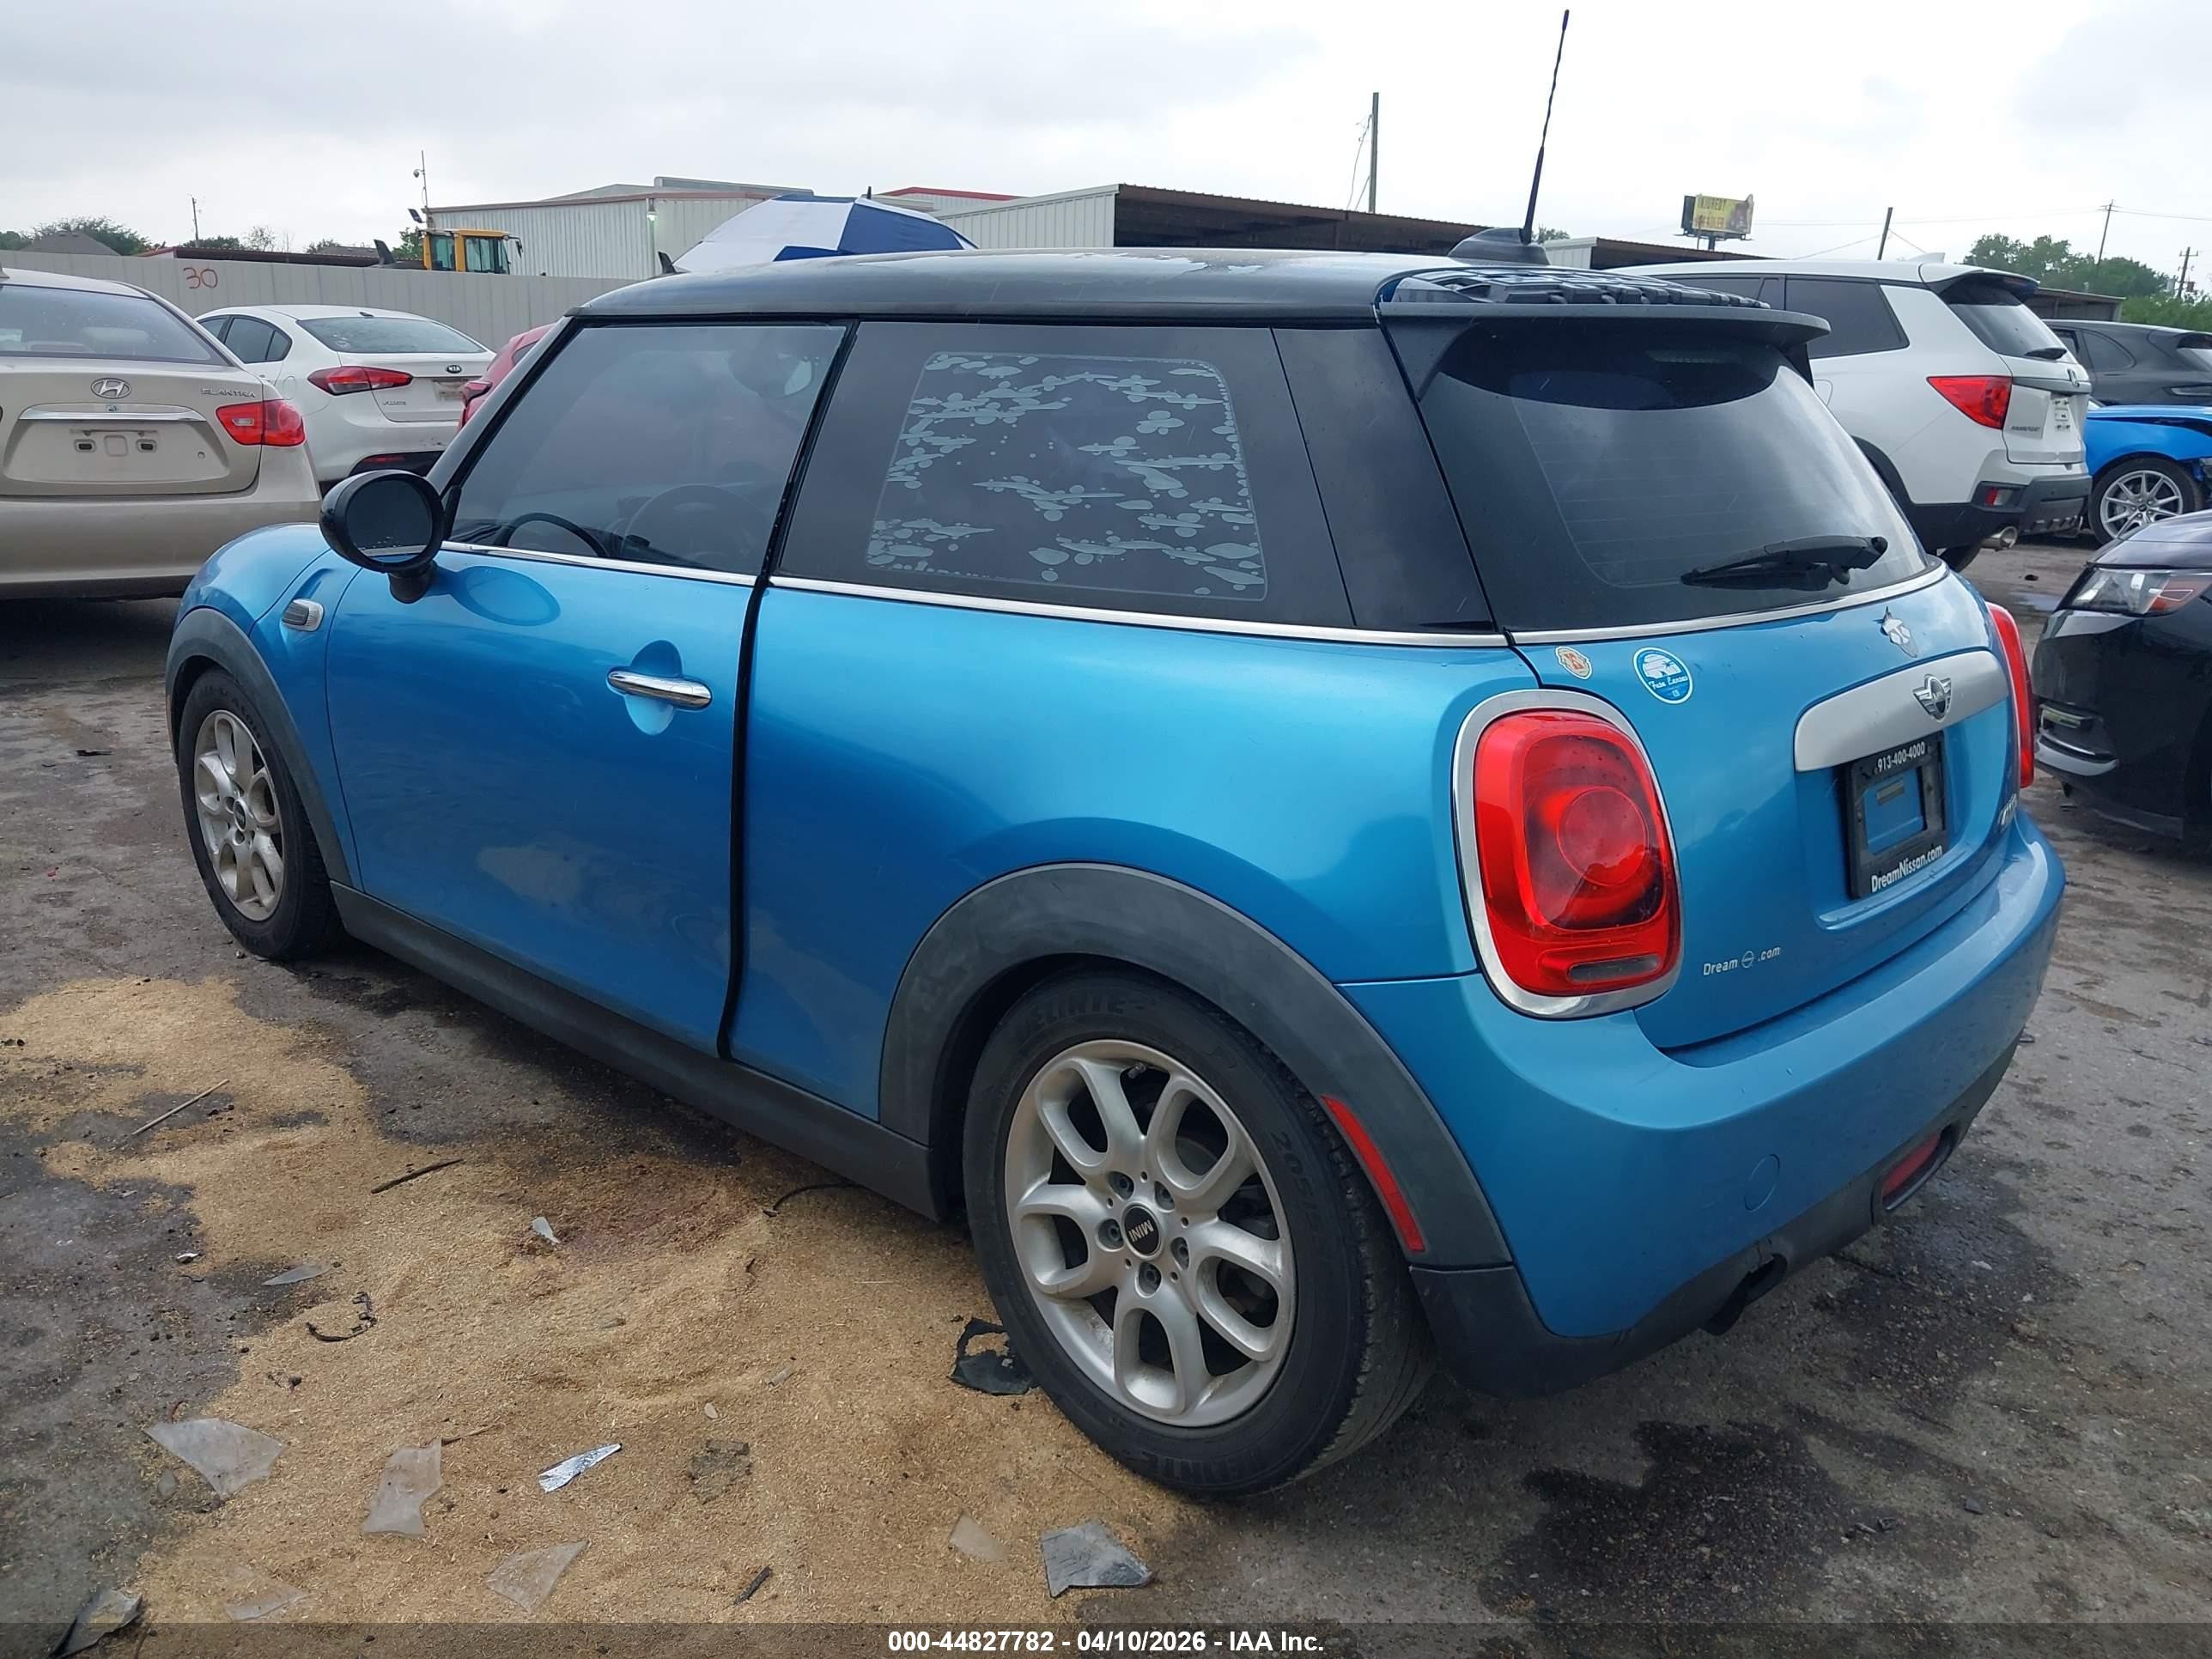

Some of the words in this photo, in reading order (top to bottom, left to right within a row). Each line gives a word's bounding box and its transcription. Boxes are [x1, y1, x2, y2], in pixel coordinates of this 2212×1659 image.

[183, 267, 218, 289] 30
[201, 388, 256, 398] ELANTRA
[1877, 742, 1925, 773] 913-400-4000
[1871, 845, 1942, 893] DreamNissan.com
[1703, 959, 1738, 975] Dream
[1758, 946, 1781, 962] .com
[1128, 1219, 1154, 1243] MINI
